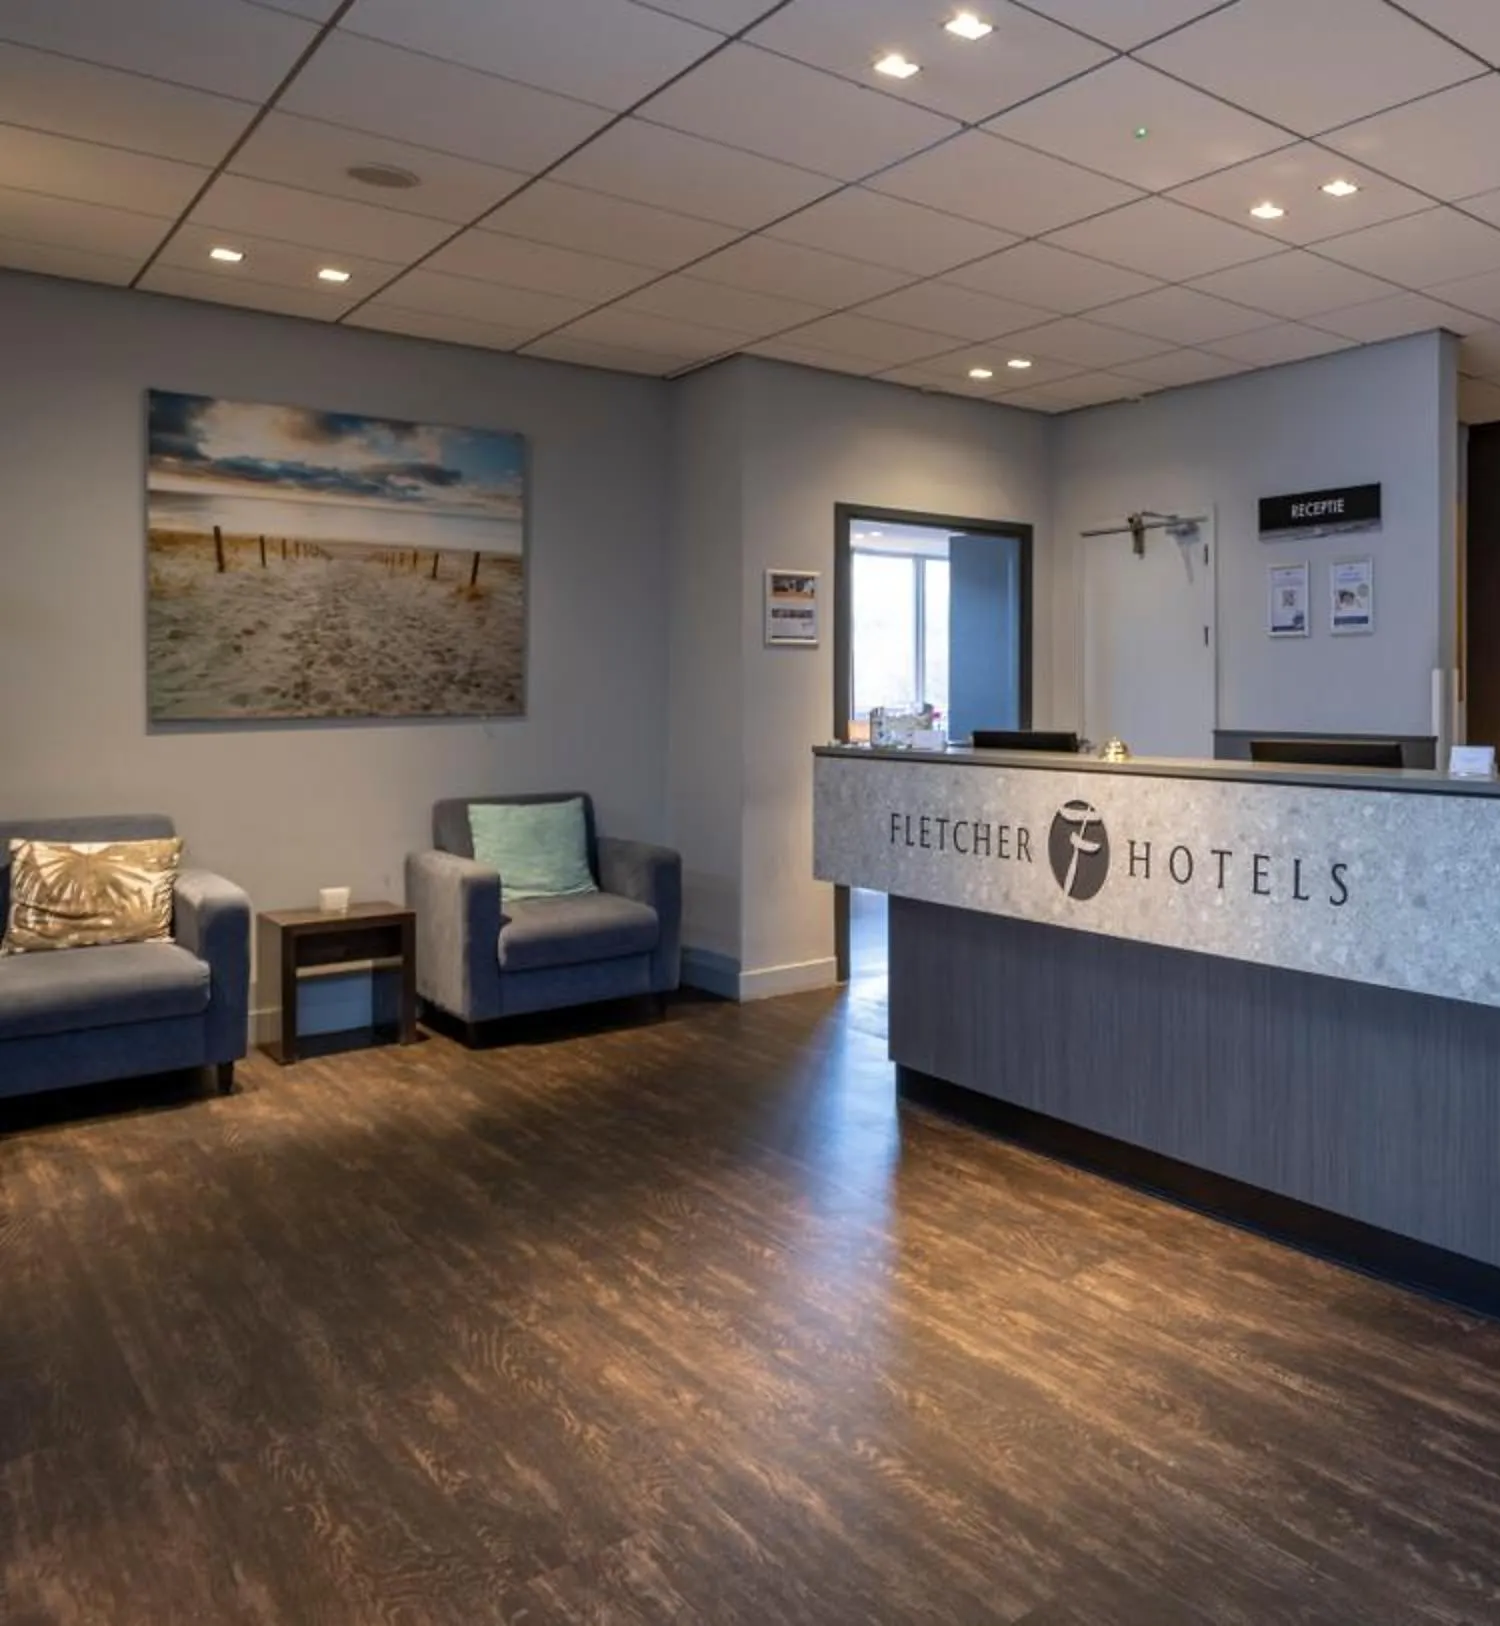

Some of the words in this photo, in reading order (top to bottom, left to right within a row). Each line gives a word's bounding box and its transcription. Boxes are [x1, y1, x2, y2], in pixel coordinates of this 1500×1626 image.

[1291, 498, 1345, 518] RECEPTIE
[890, 812, 1033, 863] FLETCHER
[1128, 839, 1349, 906] HOTELS
